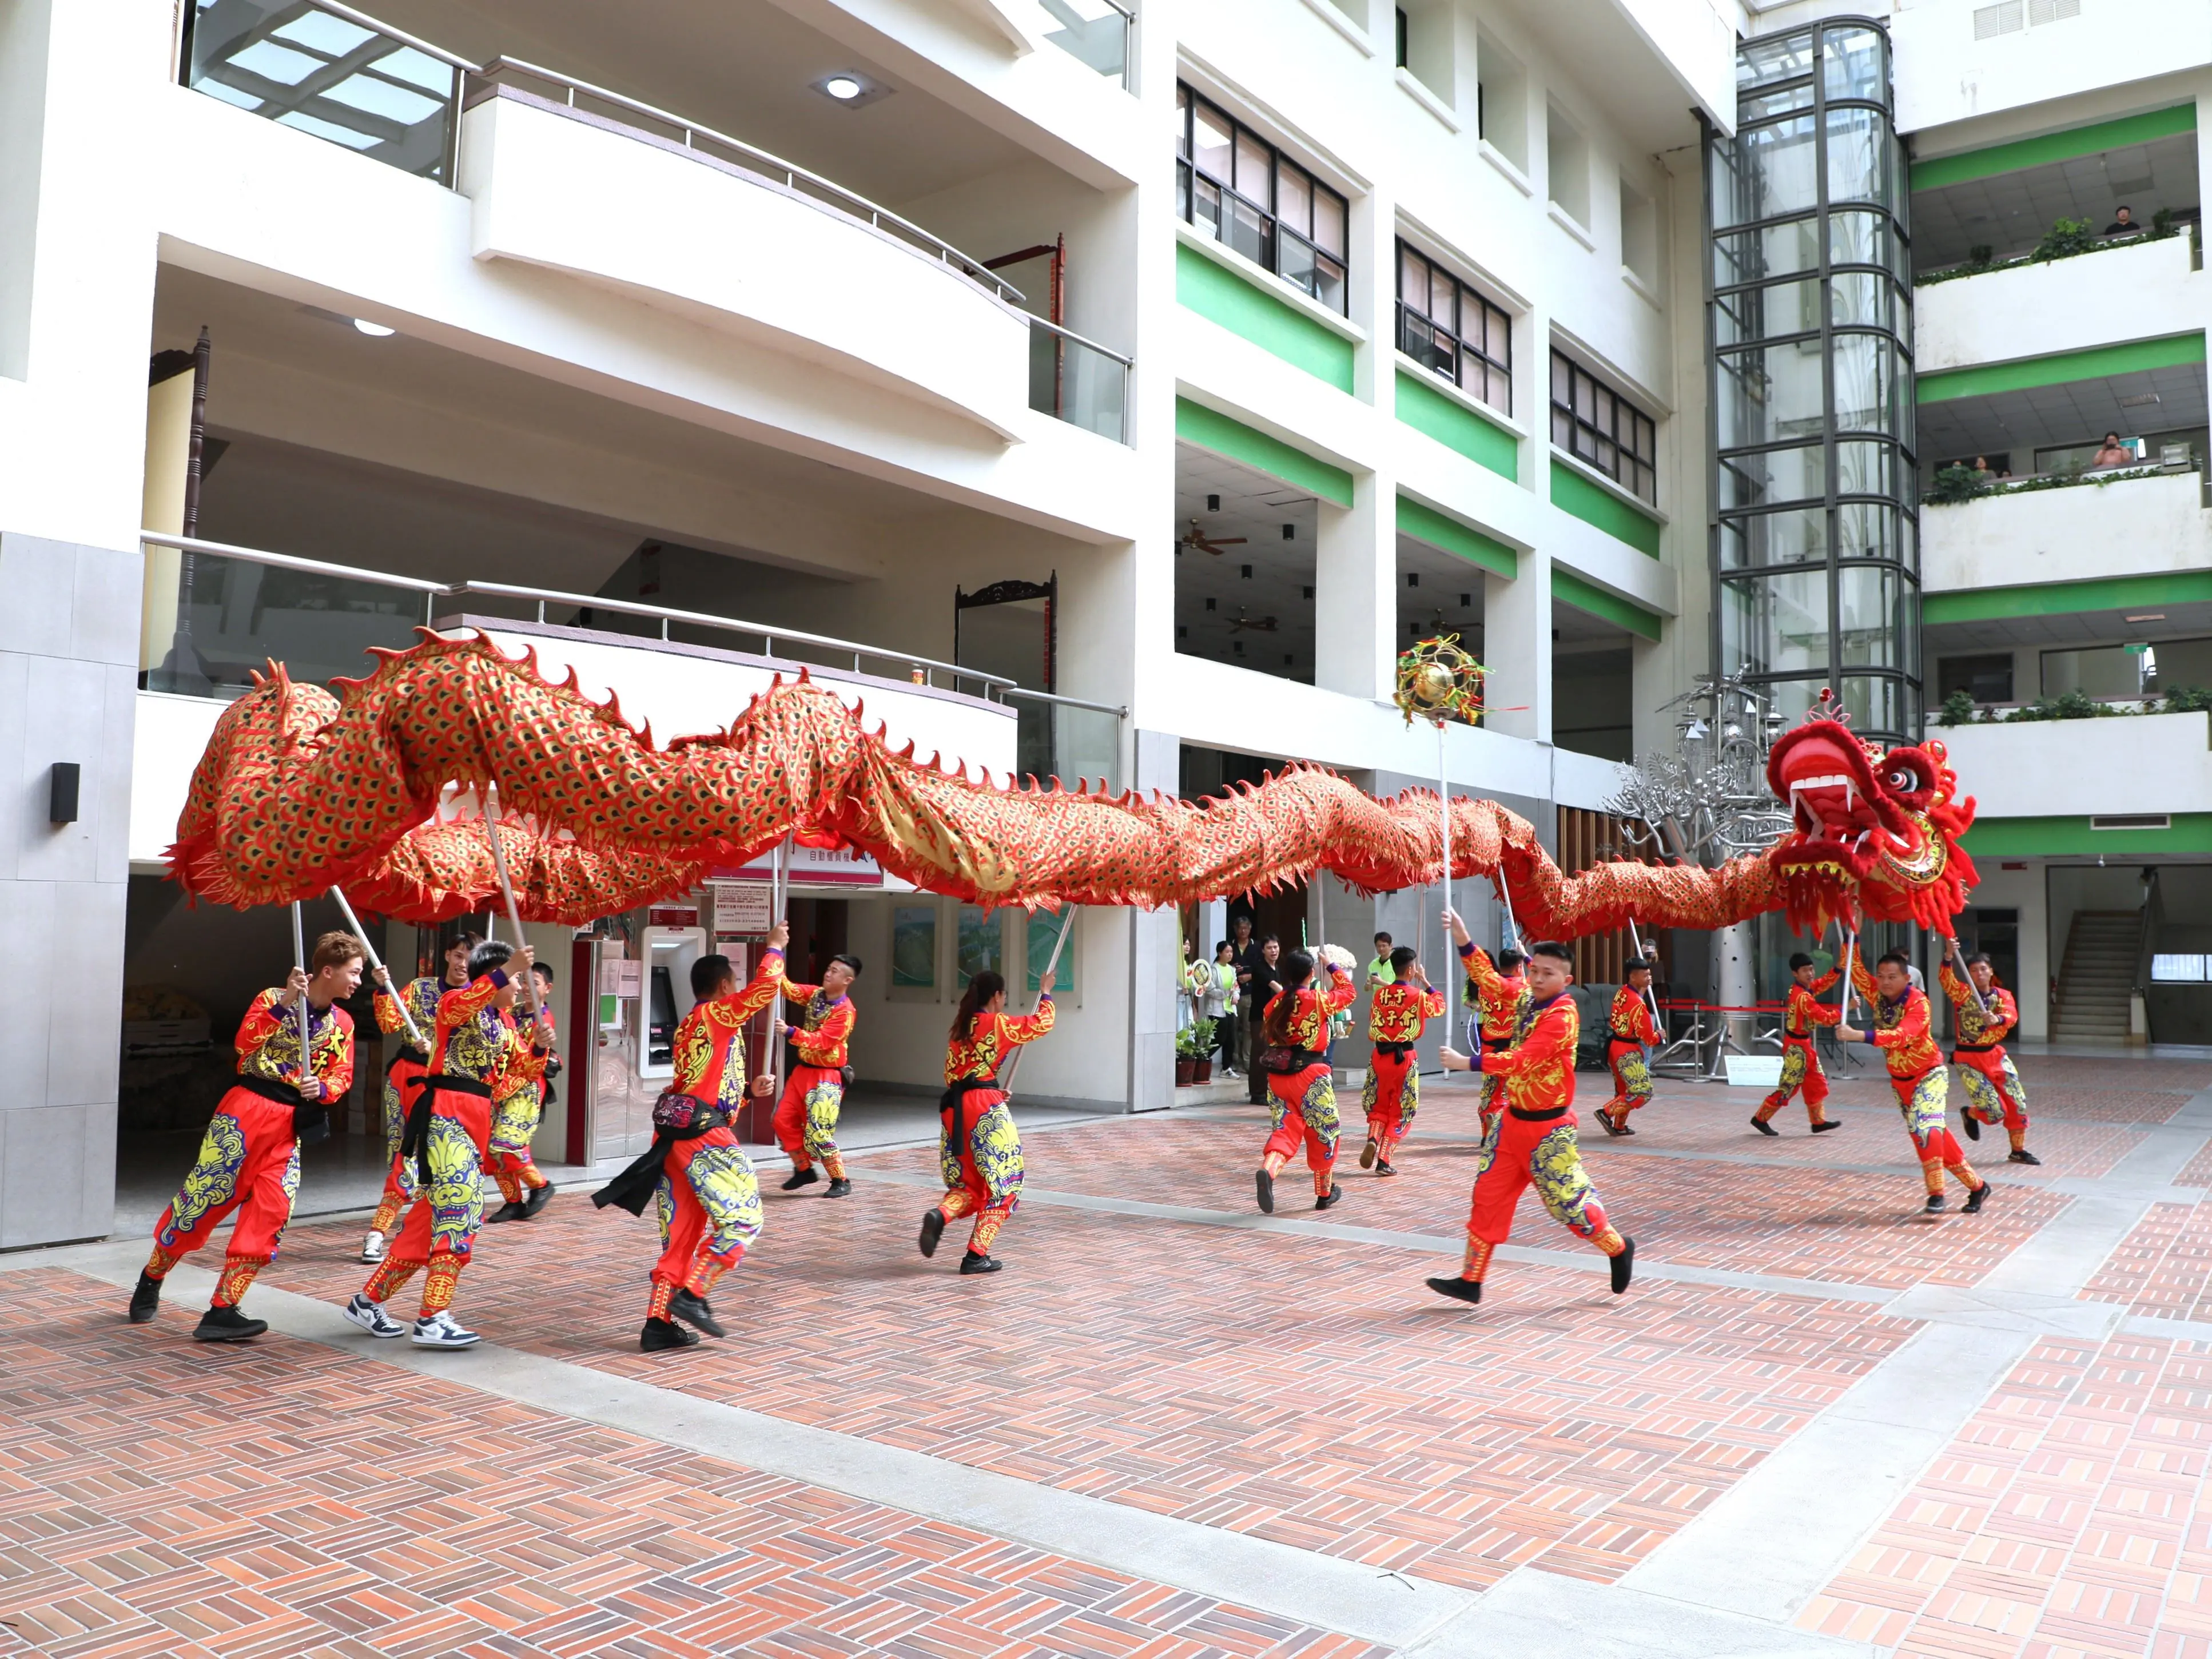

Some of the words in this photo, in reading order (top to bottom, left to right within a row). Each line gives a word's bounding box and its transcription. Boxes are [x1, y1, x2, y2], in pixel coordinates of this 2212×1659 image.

[1379, 989, 1406, 1004] 朴子
[1372, 1010, 1415, 1027] 太子會
